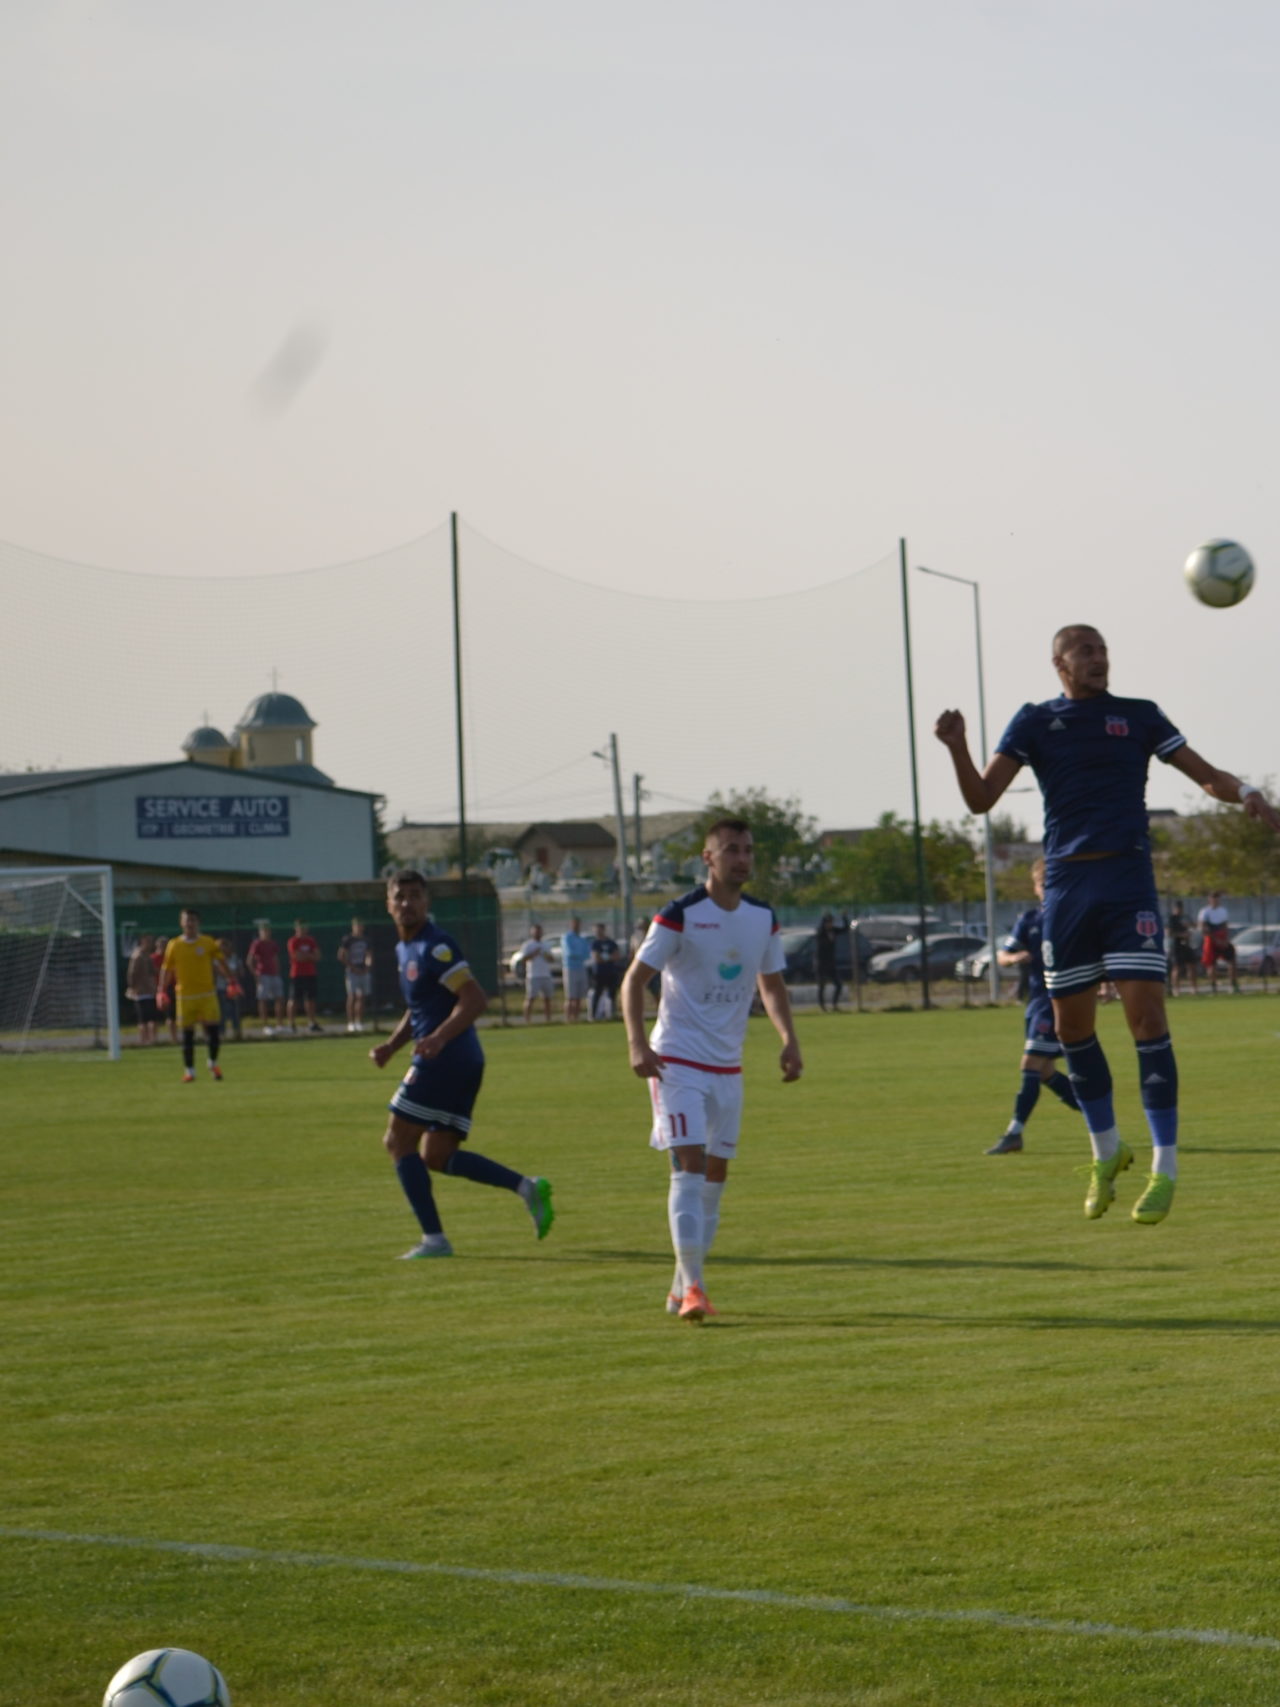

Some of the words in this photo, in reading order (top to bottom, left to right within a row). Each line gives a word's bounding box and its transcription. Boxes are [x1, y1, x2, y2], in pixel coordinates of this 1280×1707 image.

[144, 799, 220, 817] SERVICE
[231, 799, 282, 816] AUTO
[172, 824, 235, 835] GEOMETRIE
[249, 823, 283, 834] CLIMA
[668, 1112, 688, 1138] 11
